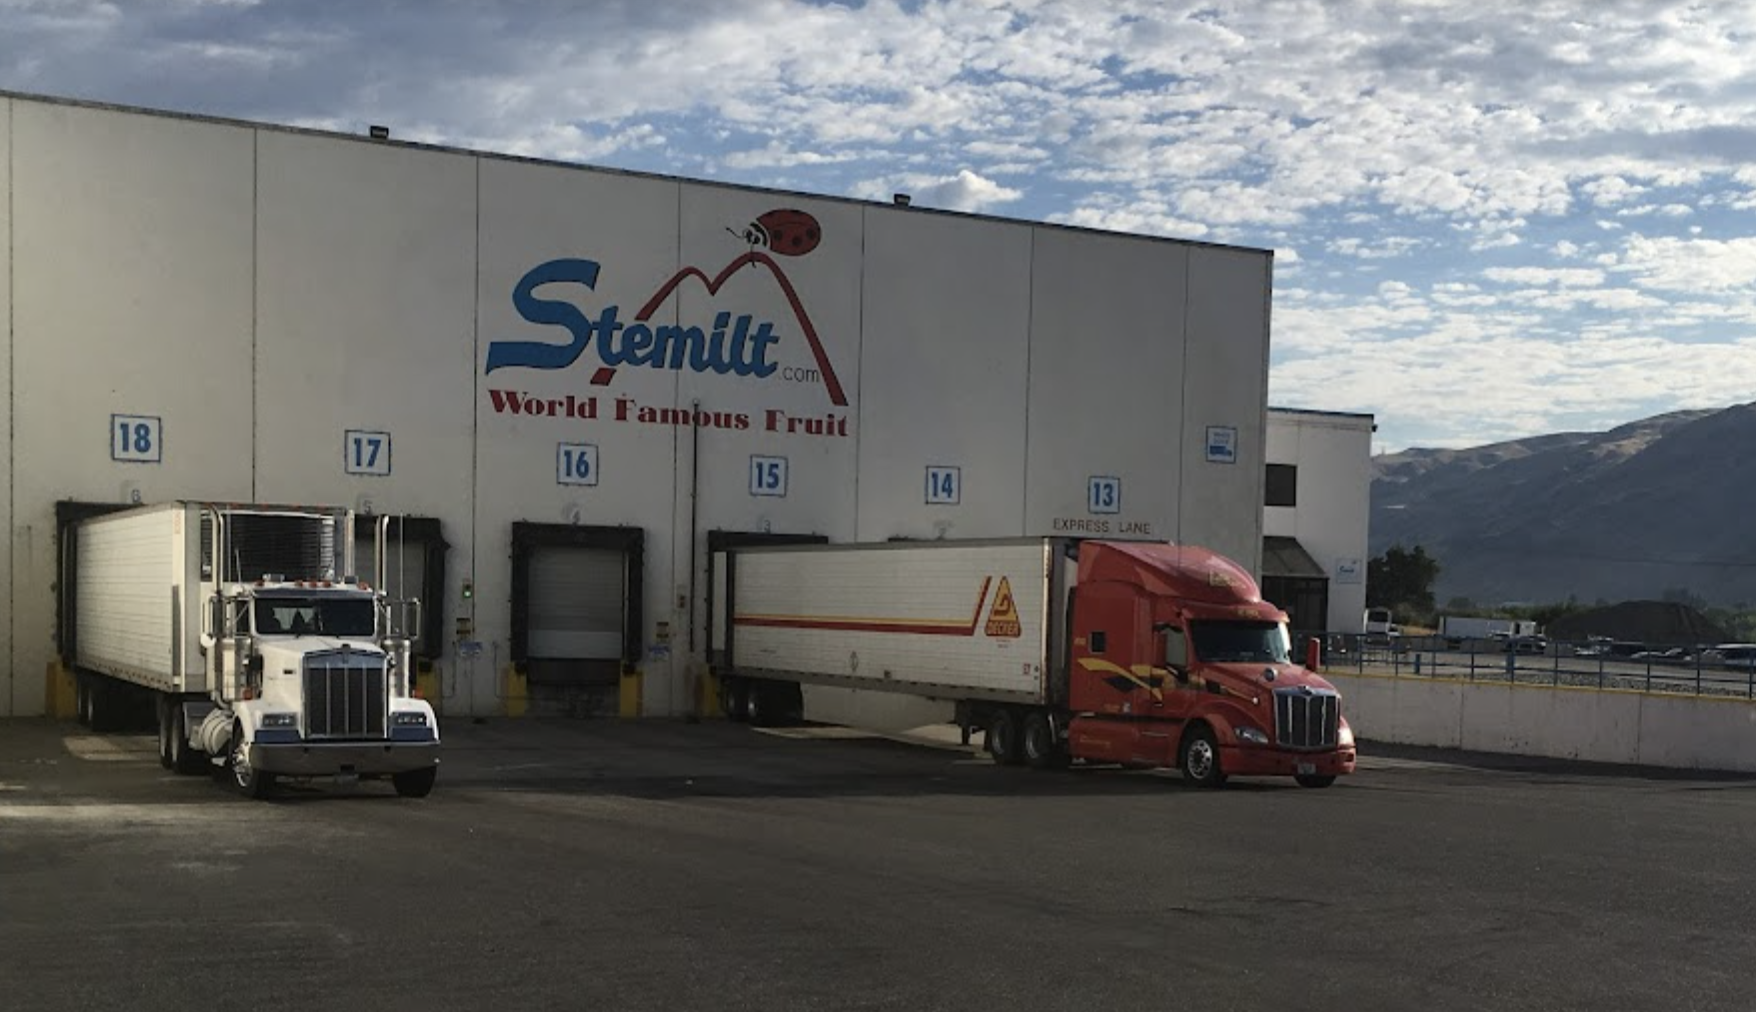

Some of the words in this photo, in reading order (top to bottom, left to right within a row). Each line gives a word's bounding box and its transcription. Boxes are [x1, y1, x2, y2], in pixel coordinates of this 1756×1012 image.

[486, 258, 780, 378] Stemilt
[488, 390, 599, 420] World
[614, 393, 750, 431] Famous
[765, 409, 850, 437] Fruit
[120, 422, 151, 453] 18
[354, 438, 382, 467] 17
[564, 450, 590, 479] 16
[756, 462, 780, 490] 15
[931, 471, 954, 498] 14
[1094, 482, 1114, 507] 13
[1053, 518, 1110, 533] EXPRESS
[1119, 520, 1151, 535] LANE
